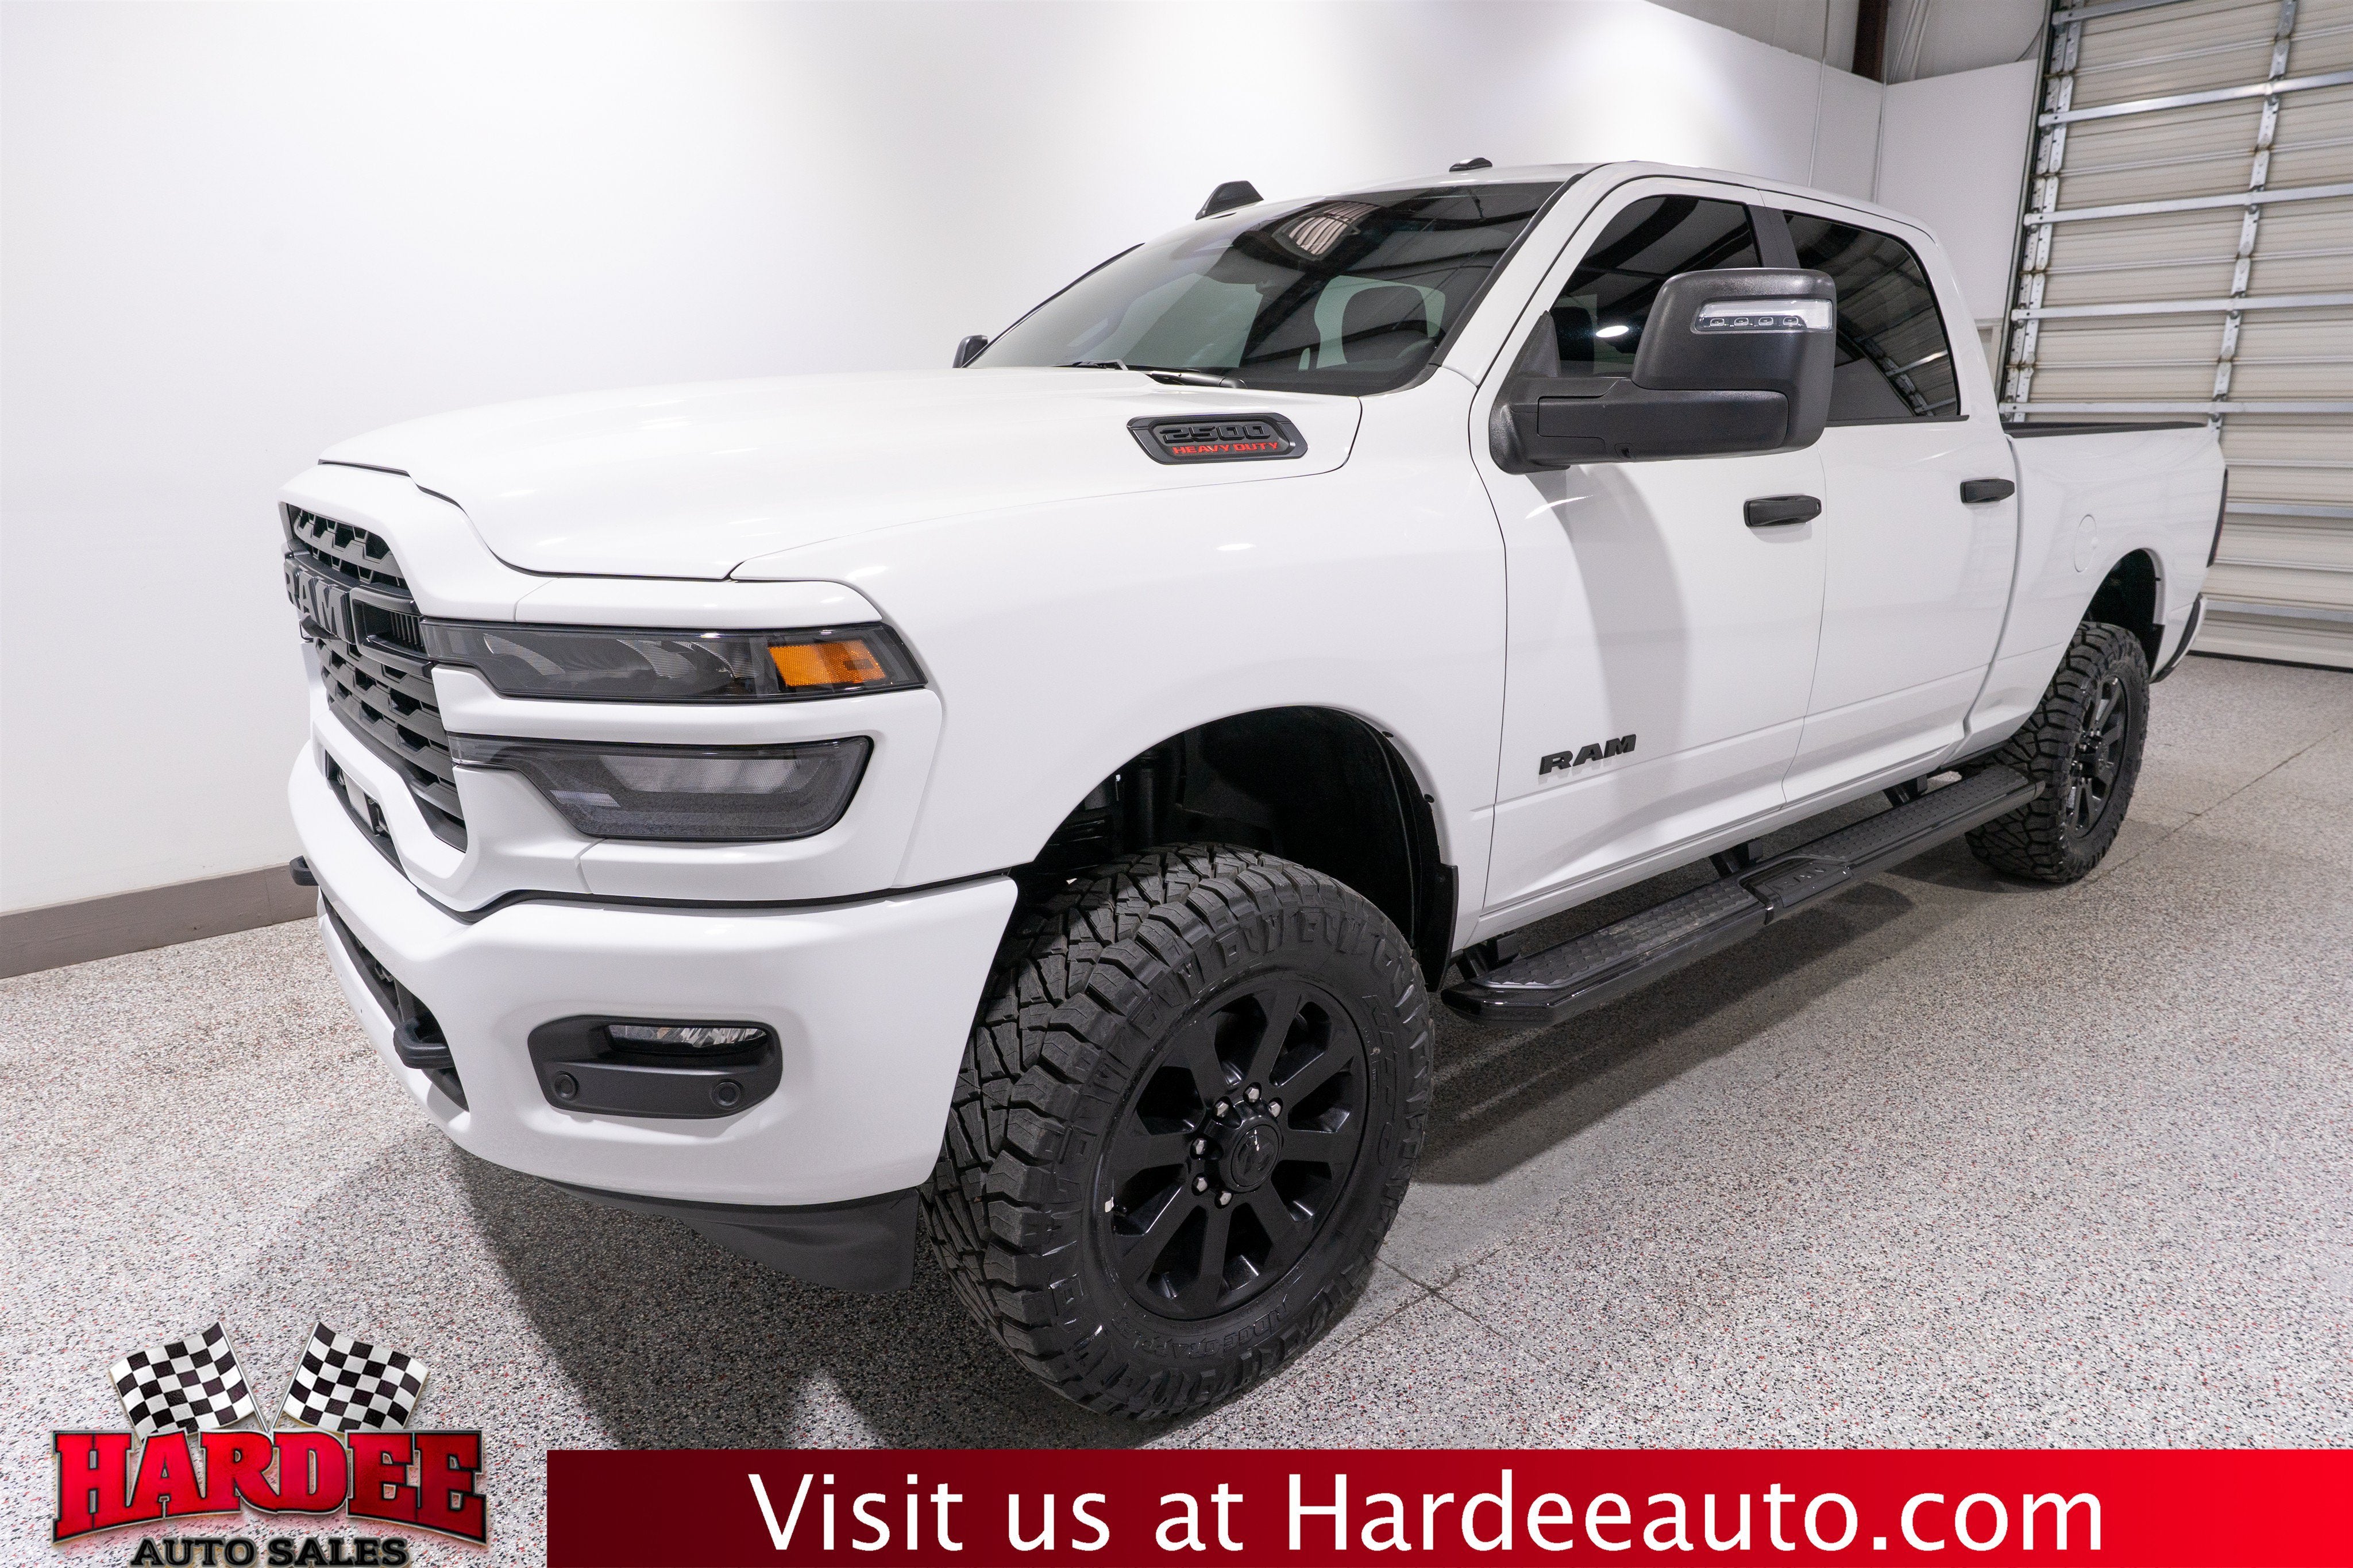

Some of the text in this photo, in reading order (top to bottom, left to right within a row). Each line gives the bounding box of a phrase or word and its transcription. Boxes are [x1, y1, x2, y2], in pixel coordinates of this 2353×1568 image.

[1159, 424, 1271, 444] 2500
[1172, 442, 1278, 454] HEAVY DUTY
[284, 562, 348, 643] RAM
[1538, 733, 1637, 775] RAM
